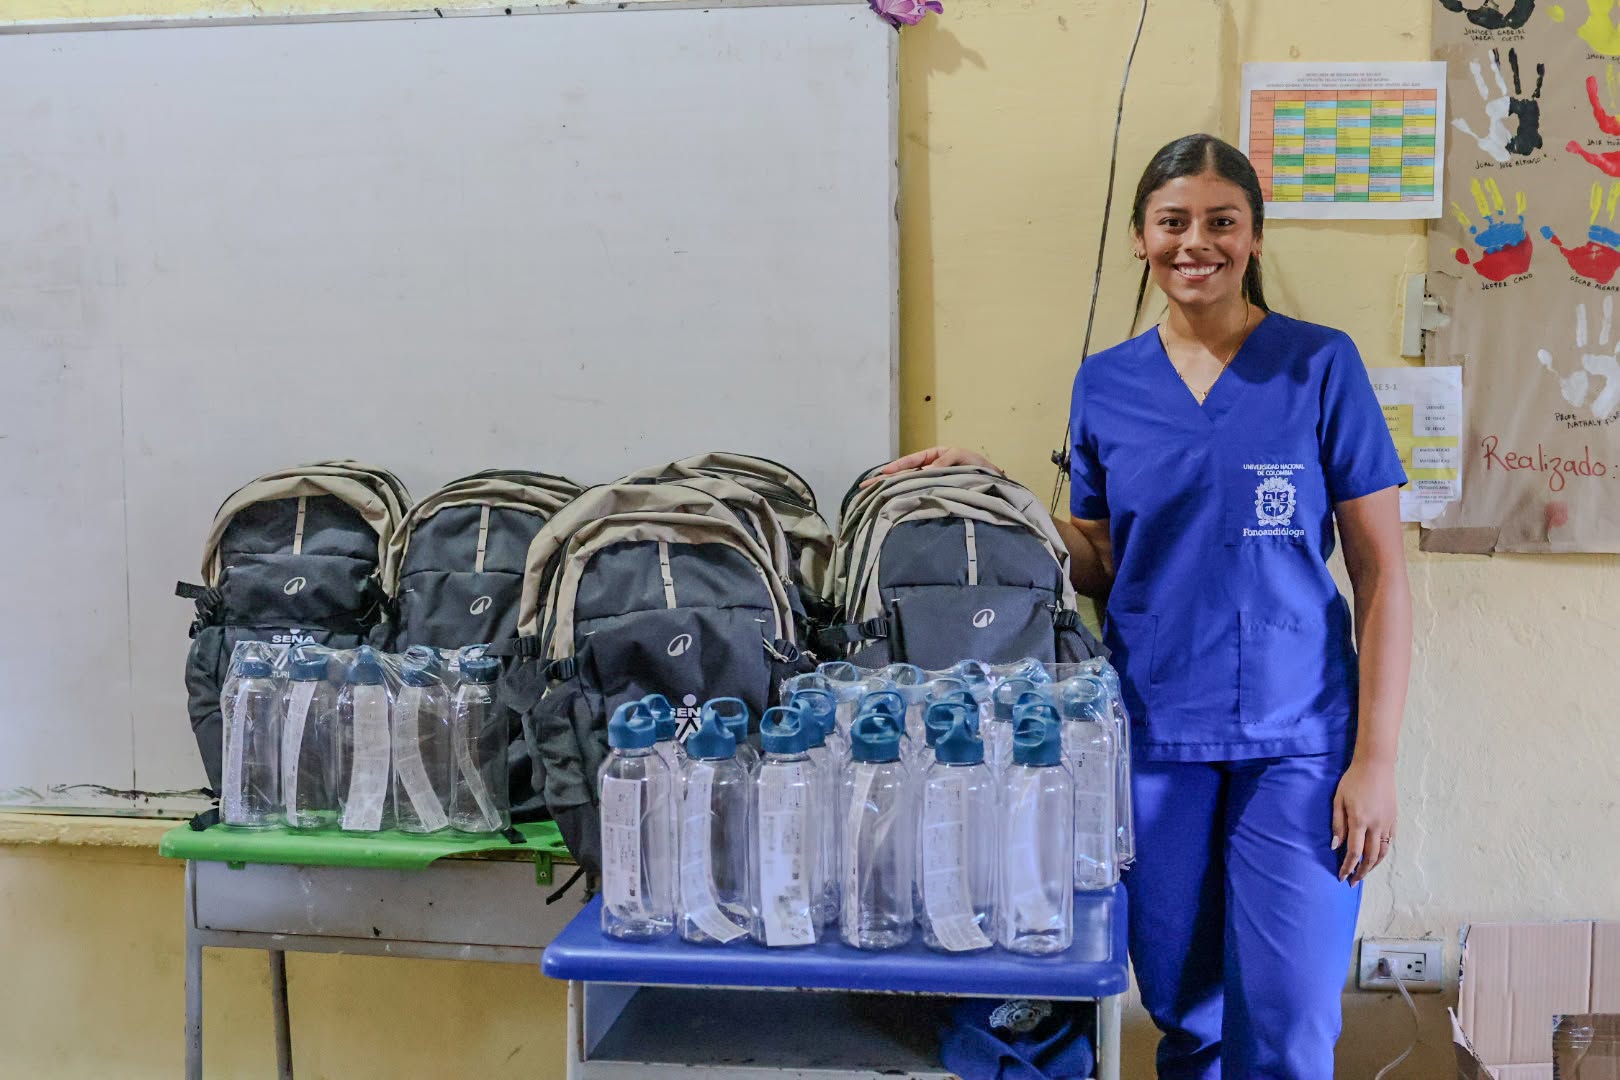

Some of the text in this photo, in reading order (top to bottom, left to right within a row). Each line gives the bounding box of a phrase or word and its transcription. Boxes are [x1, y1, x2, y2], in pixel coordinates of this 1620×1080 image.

[1570, 276, 1591, 286] OSCAR
[1567, 420, 1601, 429] NATHALY
[272, 634, 316, 644] SENA
